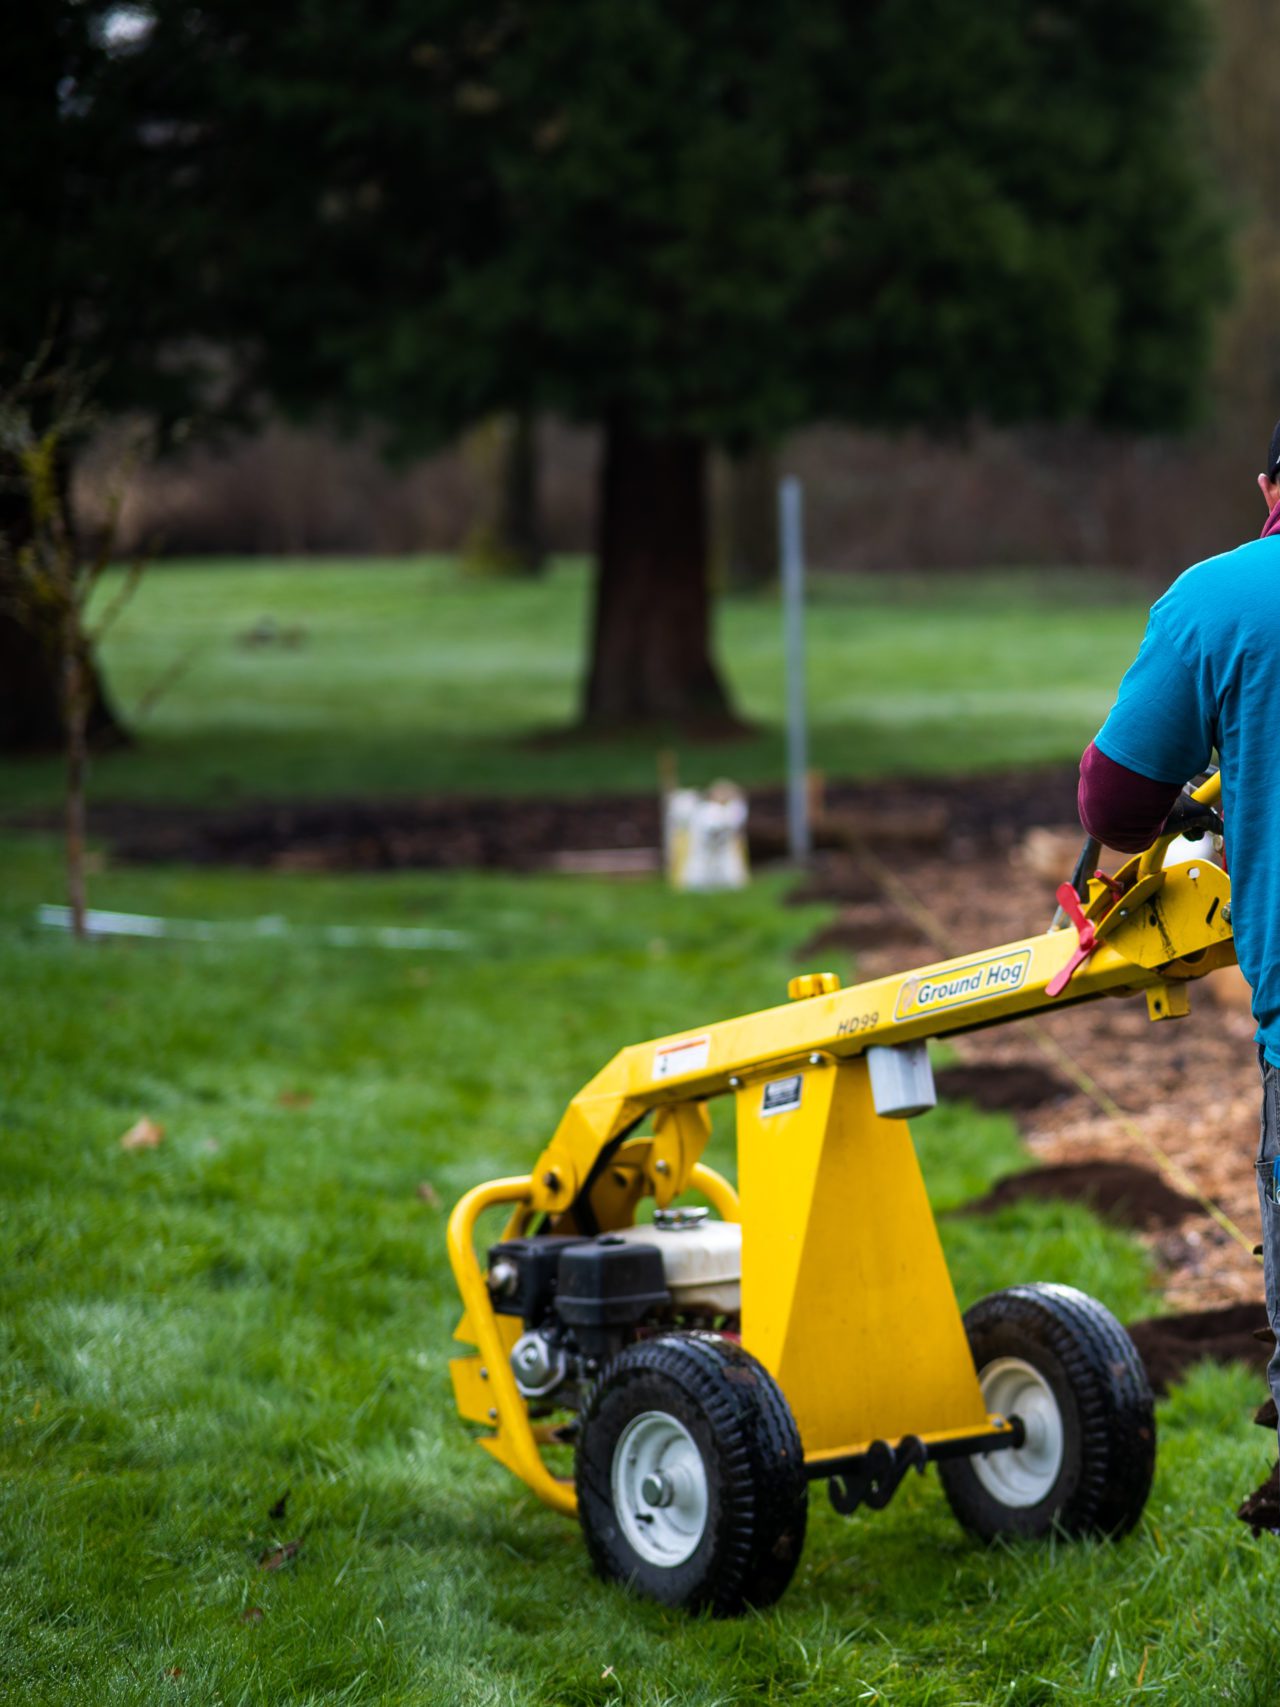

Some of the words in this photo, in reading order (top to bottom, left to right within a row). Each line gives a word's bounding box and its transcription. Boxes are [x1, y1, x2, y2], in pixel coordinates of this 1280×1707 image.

[918, 969, 983, 1004] Ground
[986, 962, 1023, 985] Hog
[837, 1011, 880, 1036] HD99
